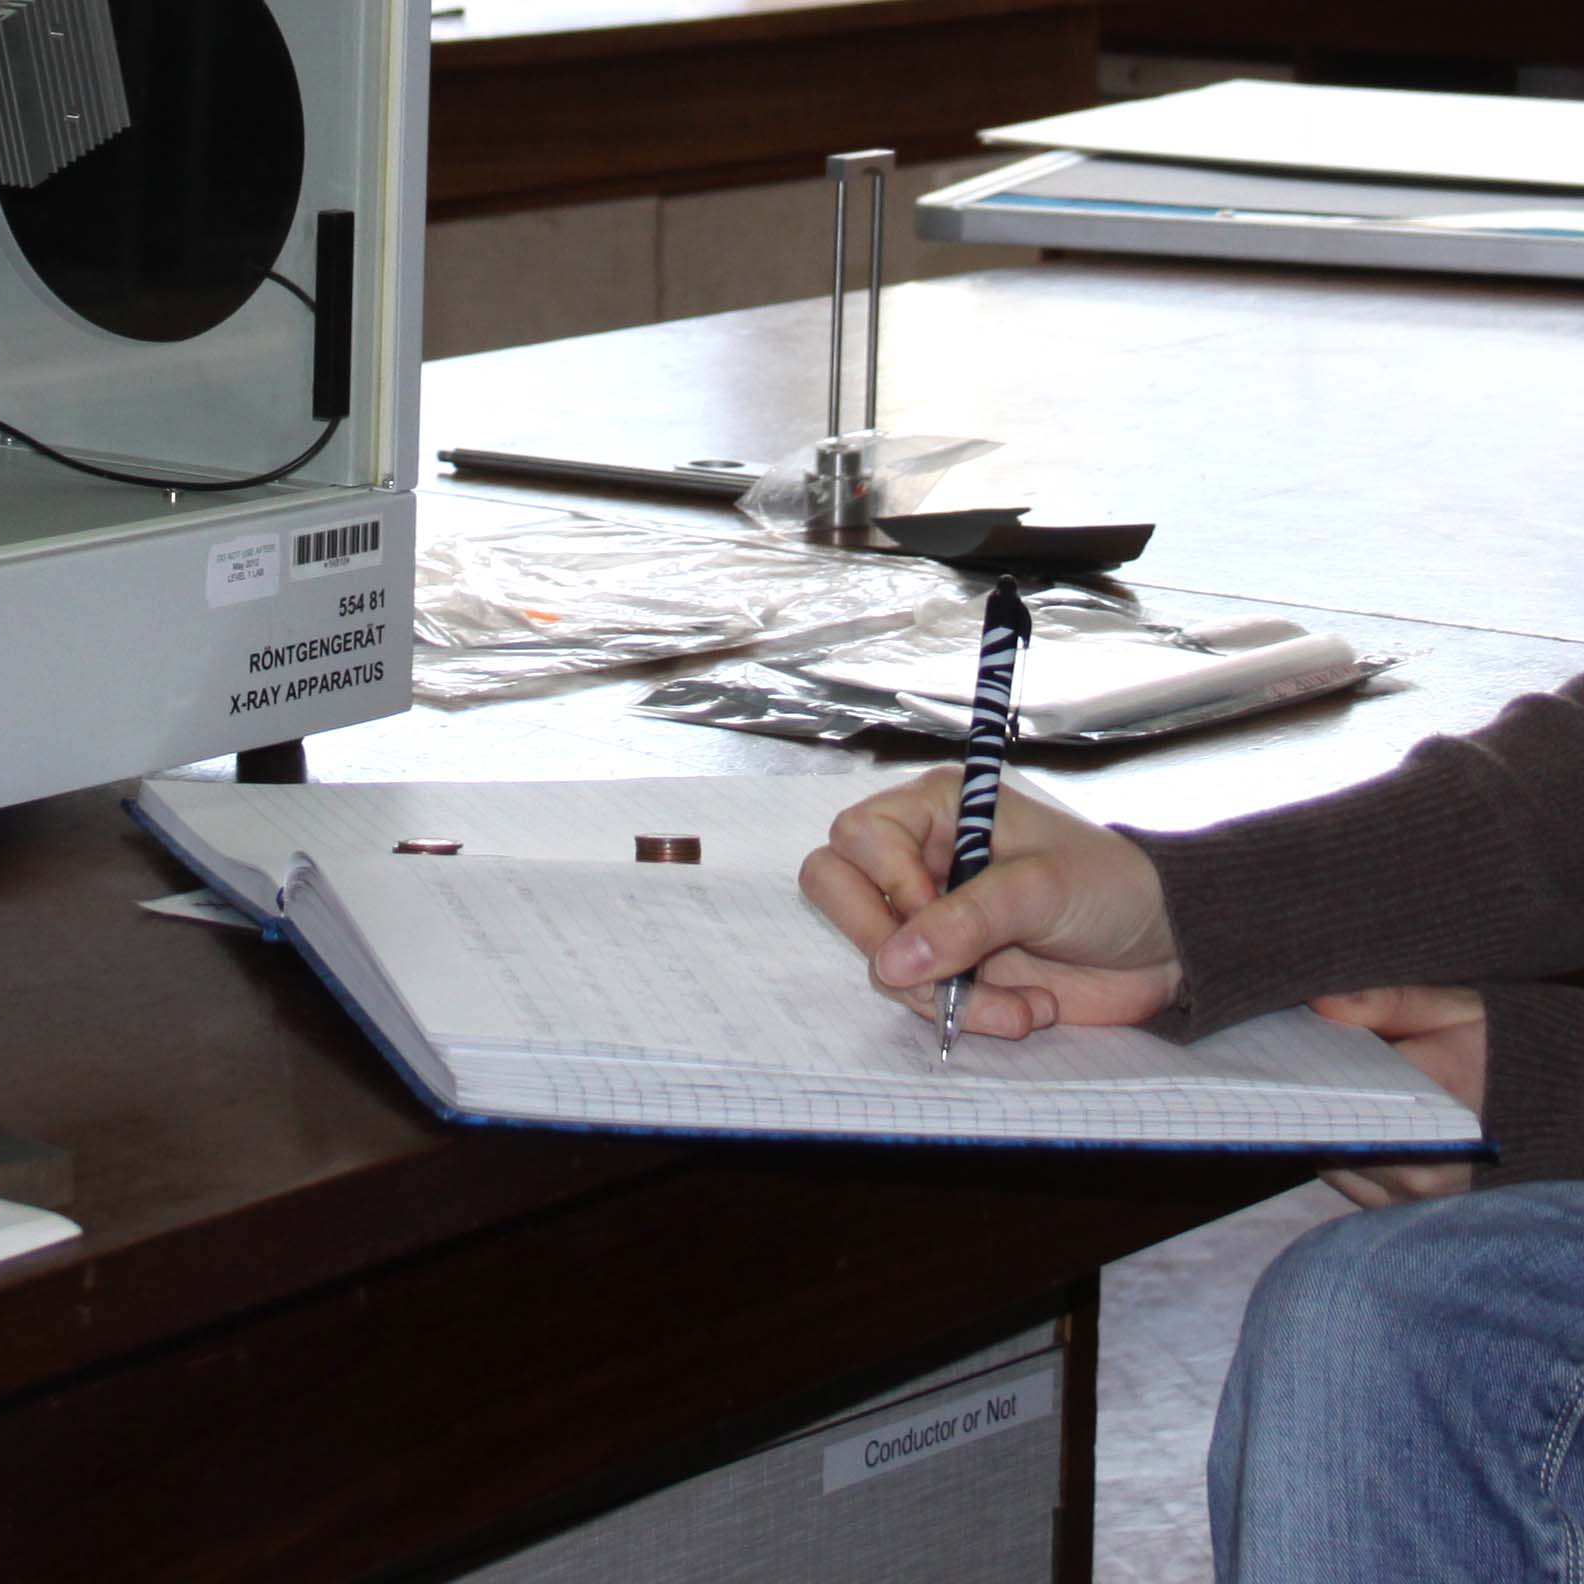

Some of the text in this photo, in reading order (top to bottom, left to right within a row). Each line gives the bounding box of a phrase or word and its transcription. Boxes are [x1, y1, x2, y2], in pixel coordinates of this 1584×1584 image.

[227, 572, 246, 583] LEVEL
[338, 588, 386, 617] 554 81
[248, 623, 386, 673] RÖNTGENGERÄT
[229, 661, 384, 716] X-RAY APPARATUS
[865, 1394, 1017, 1468] Conductor or Not
